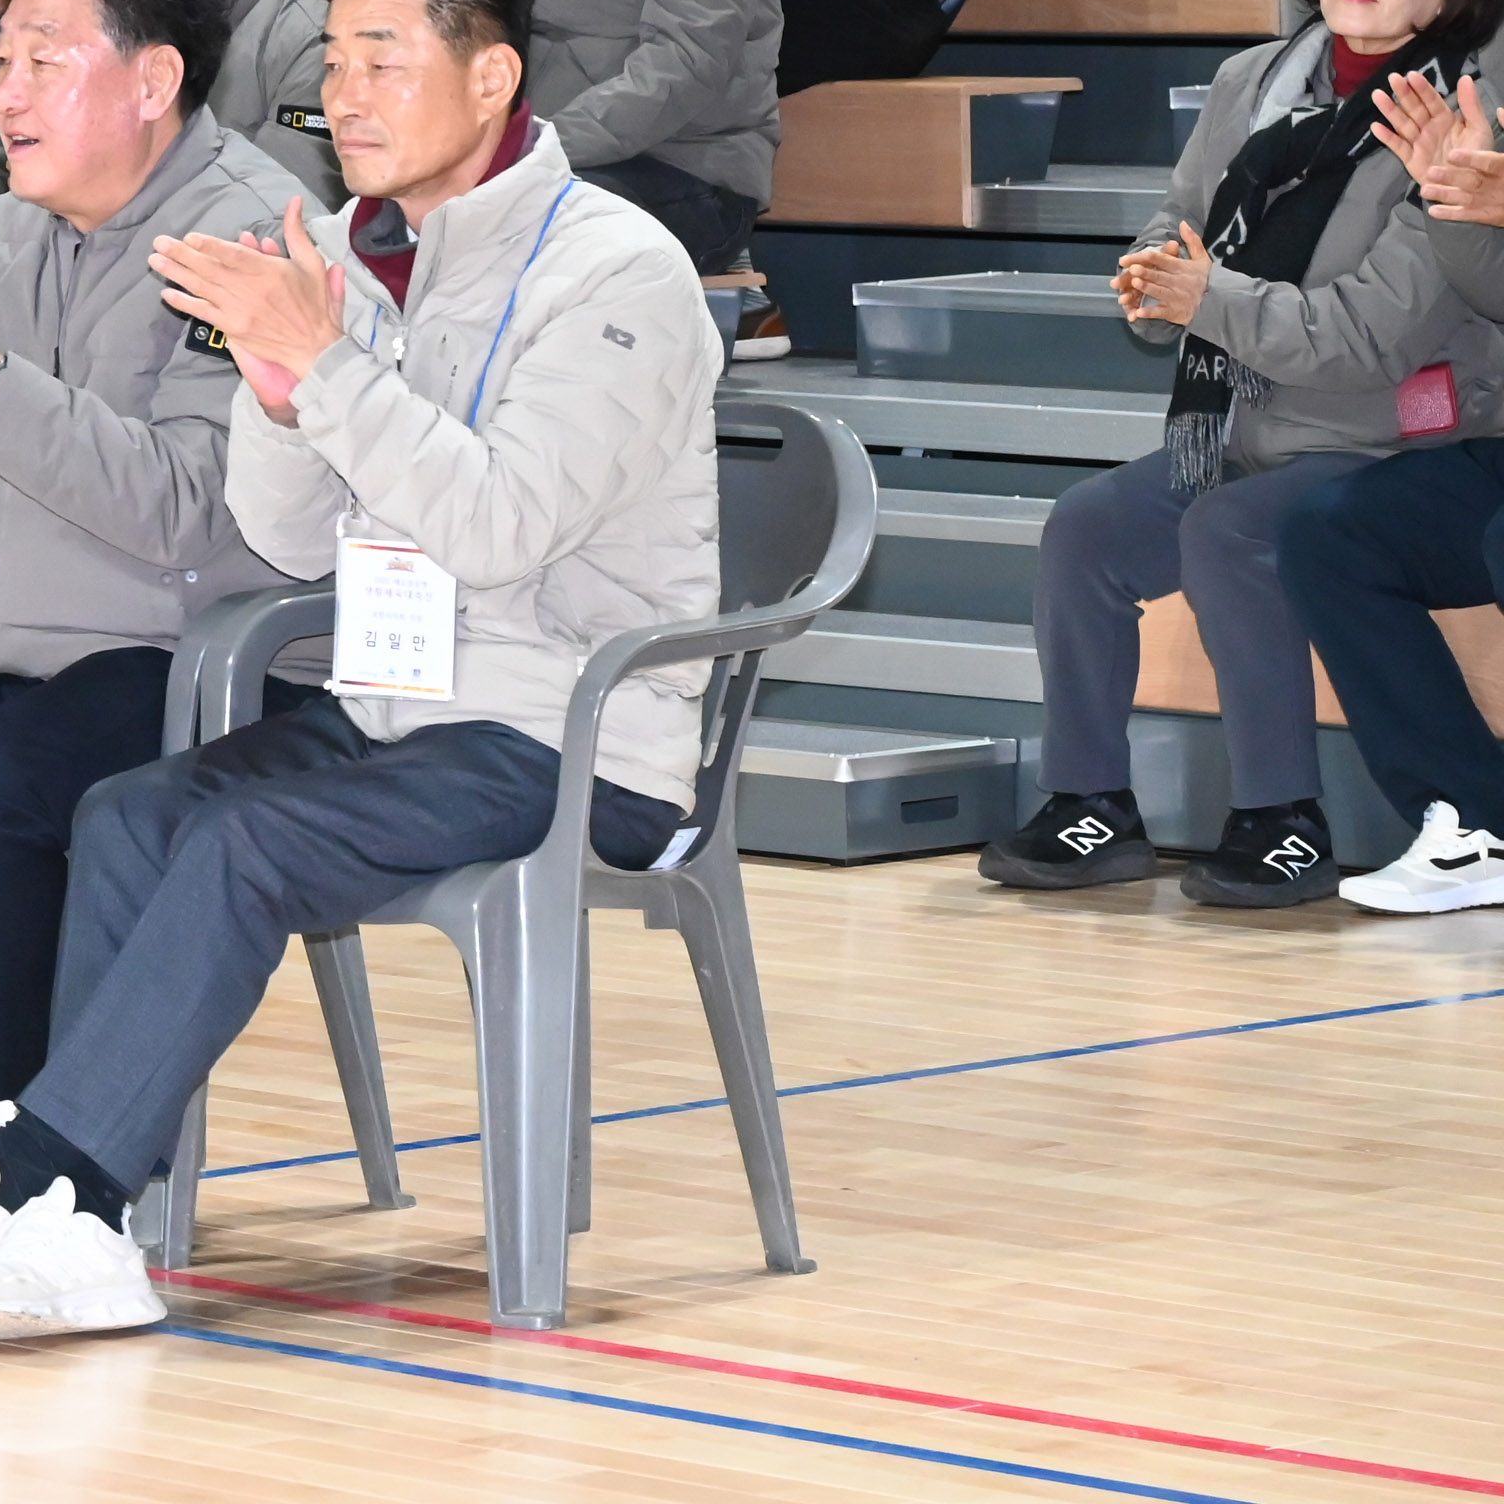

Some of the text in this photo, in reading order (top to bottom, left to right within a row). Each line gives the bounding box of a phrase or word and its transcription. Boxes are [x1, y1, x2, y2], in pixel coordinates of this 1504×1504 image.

[602, 323, 636, 350] K2
[1057, 816, 1114, 856] N
[1263, 834, 1320, 880] N
